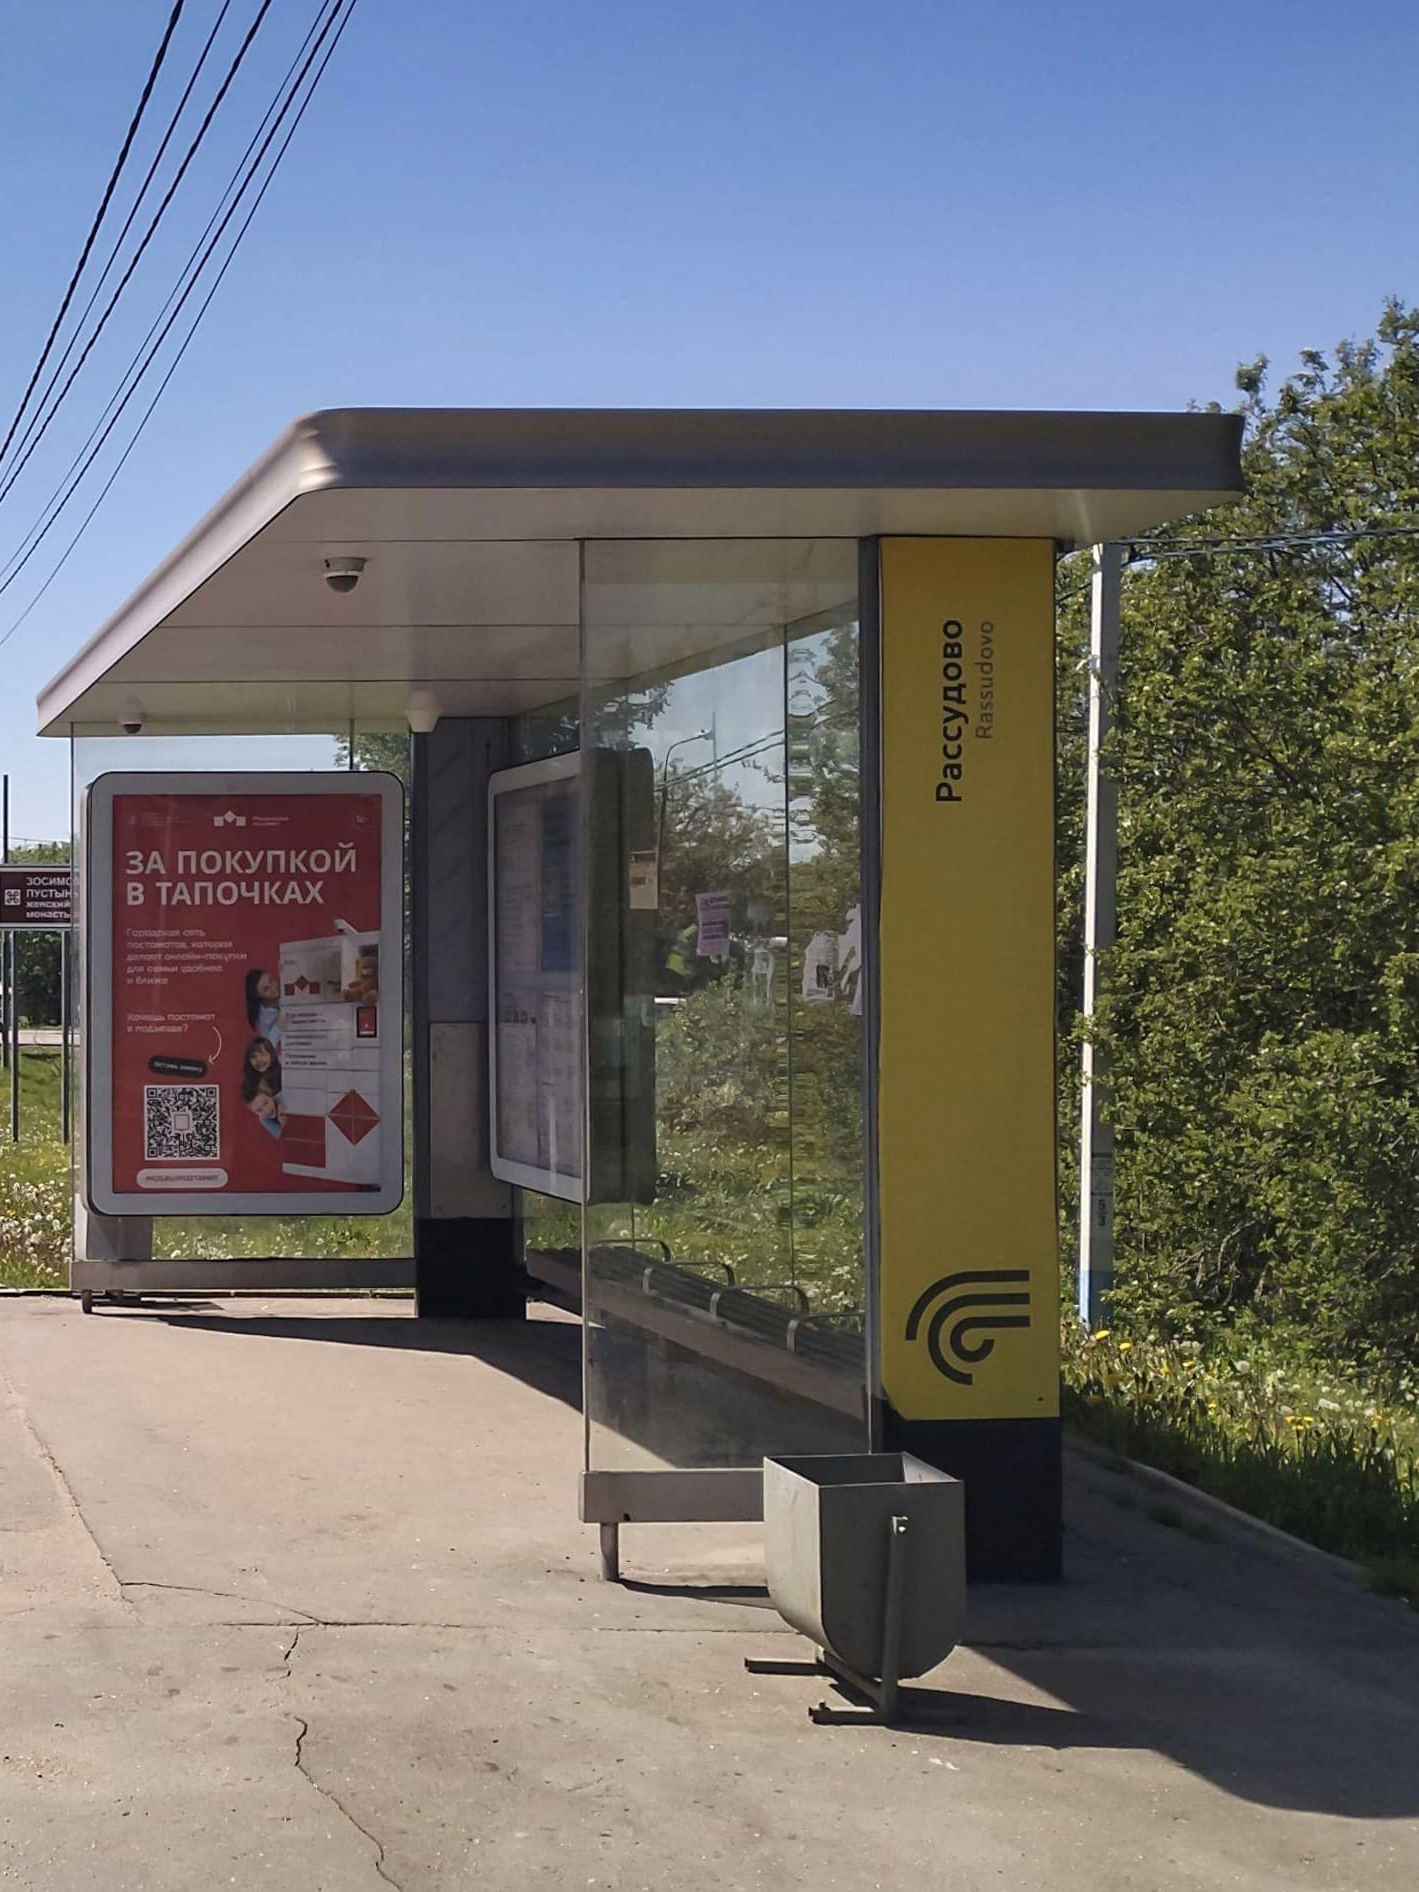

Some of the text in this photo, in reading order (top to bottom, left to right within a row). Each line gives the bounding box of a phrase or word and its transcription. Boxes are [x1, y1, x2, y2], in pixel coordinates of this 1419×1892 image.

[935, 619, 969, 801] Рассудово
[975, 621, 995, 739] Rassudovo
[125, 841, 357, 875] ЗА ПОКУПКОЙ
[126, 880, 324, 906] В ТАПОЧКАХ
